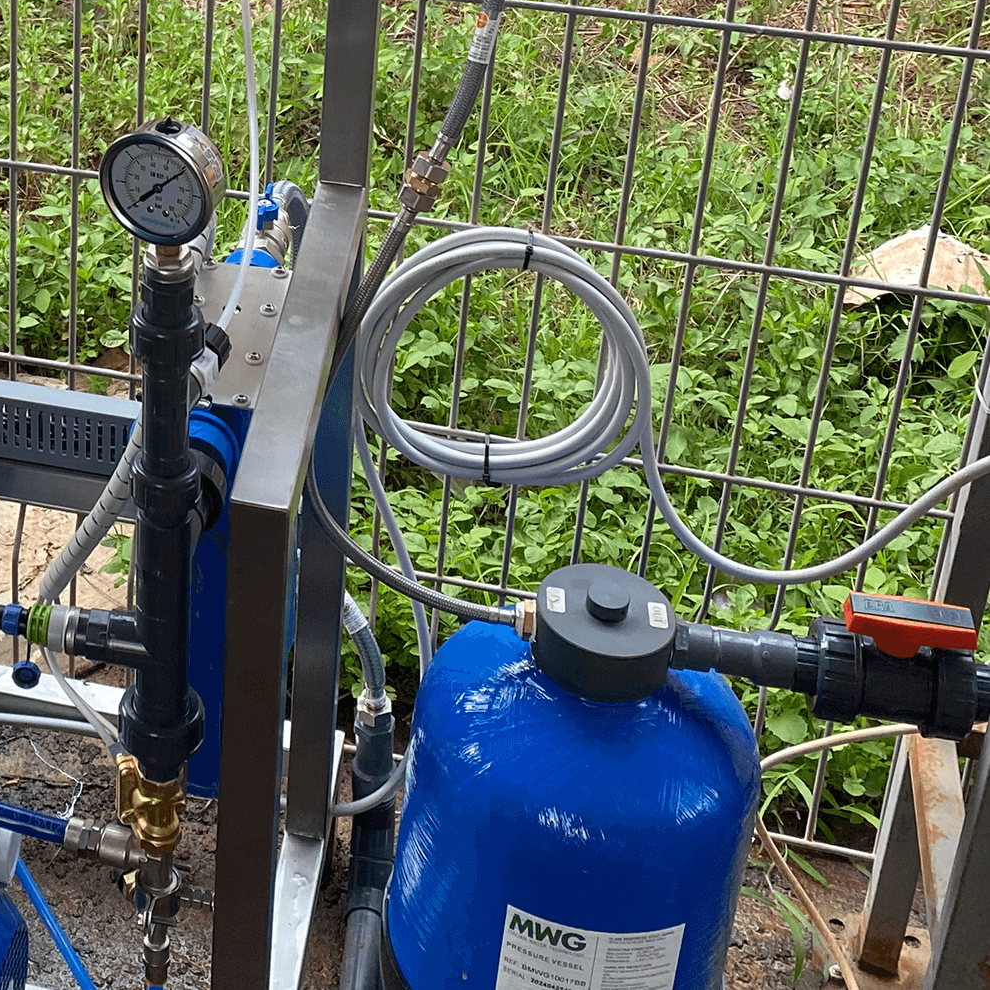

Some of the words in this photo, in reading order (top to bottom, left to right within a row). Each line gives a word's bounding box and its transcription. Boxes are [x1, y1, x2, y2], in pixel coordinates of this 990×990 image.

[508, 930, 528, 942] ITALIAN
[528, 938, 547, 948] WATER
[549, 946, 585, 958] TECHNOLOGY
[509, 913, 587, 952] MWG
[506, 941, 550, 963] PRESSURE
[552, 959, 584, 971] VESSEL
[503, 966, 526, 980] SERIAL
[521, 964, 586, 987] BMWG10017BB
